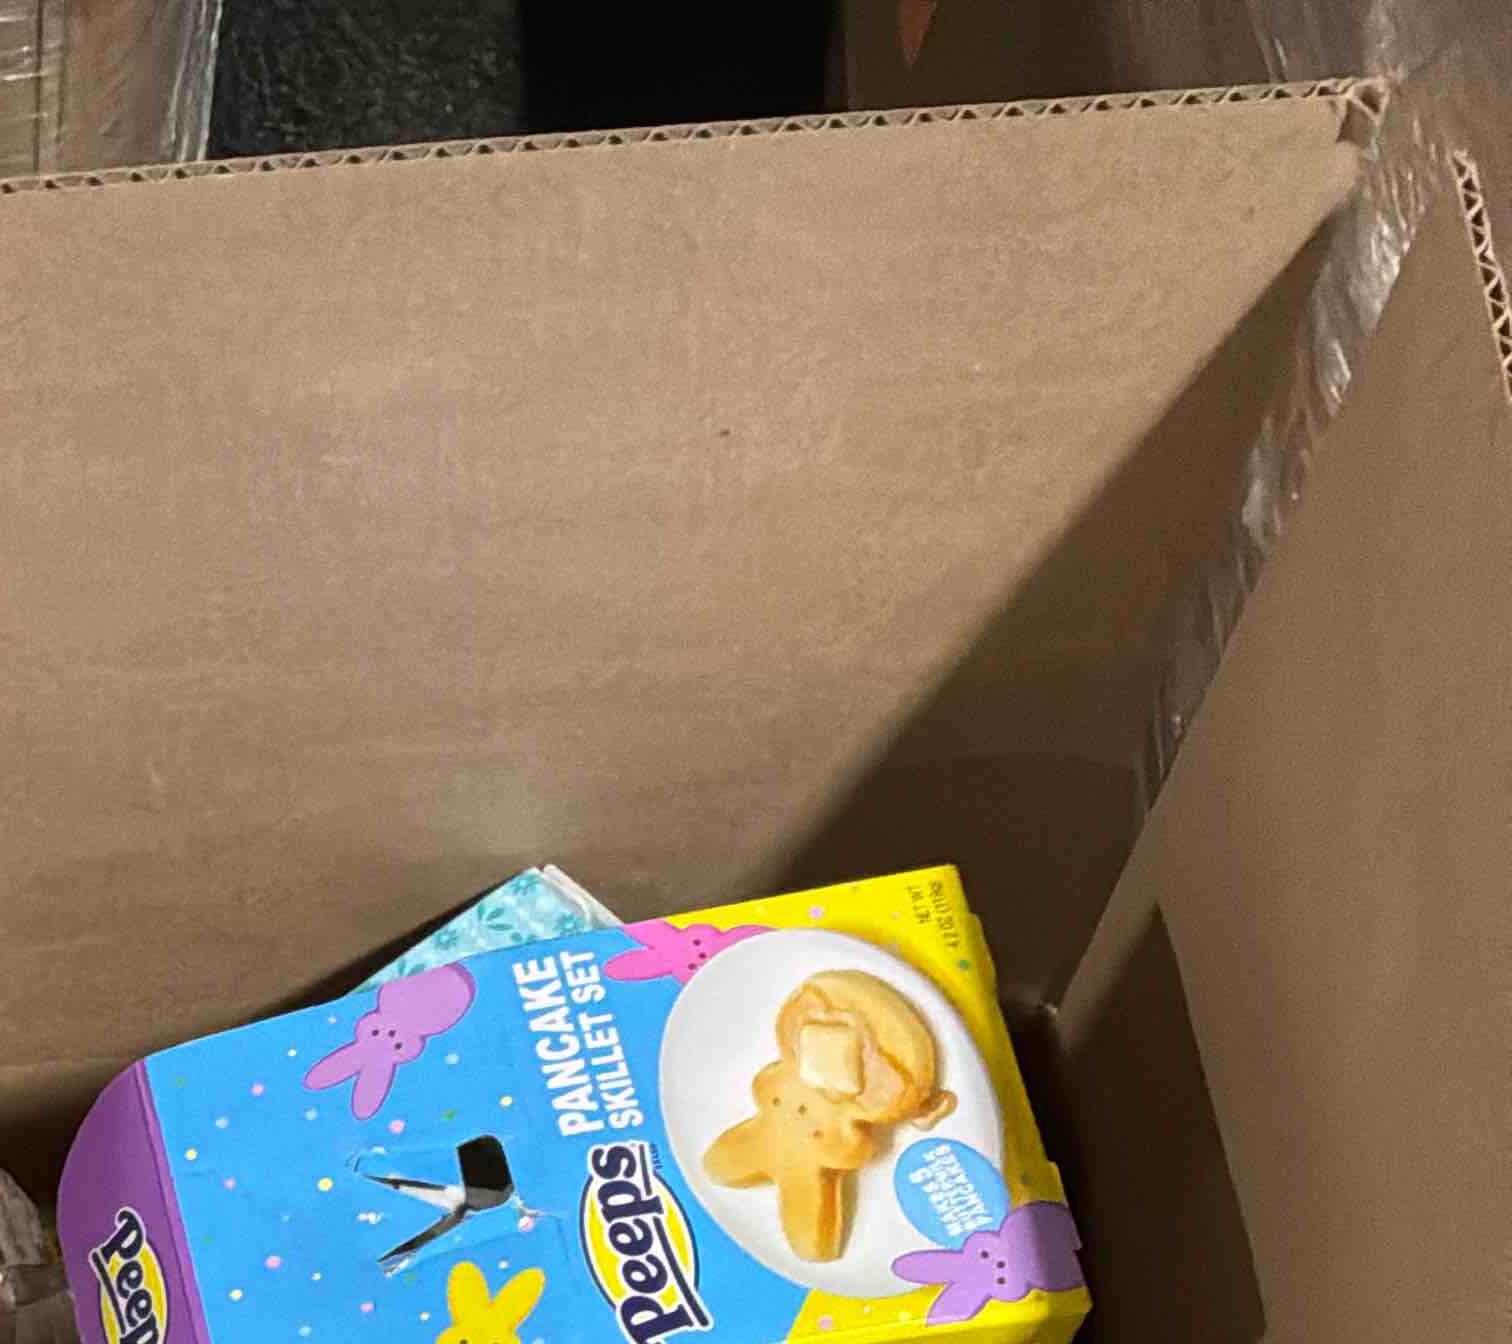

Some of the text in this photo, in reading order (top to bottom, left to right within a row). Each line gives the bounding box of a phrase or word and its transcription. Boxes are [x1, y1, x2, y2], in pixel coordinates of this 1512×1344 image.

[512, 952, 604, 1137] PANCAKE
[558, 949, 644, 1129] SKILLET SET
